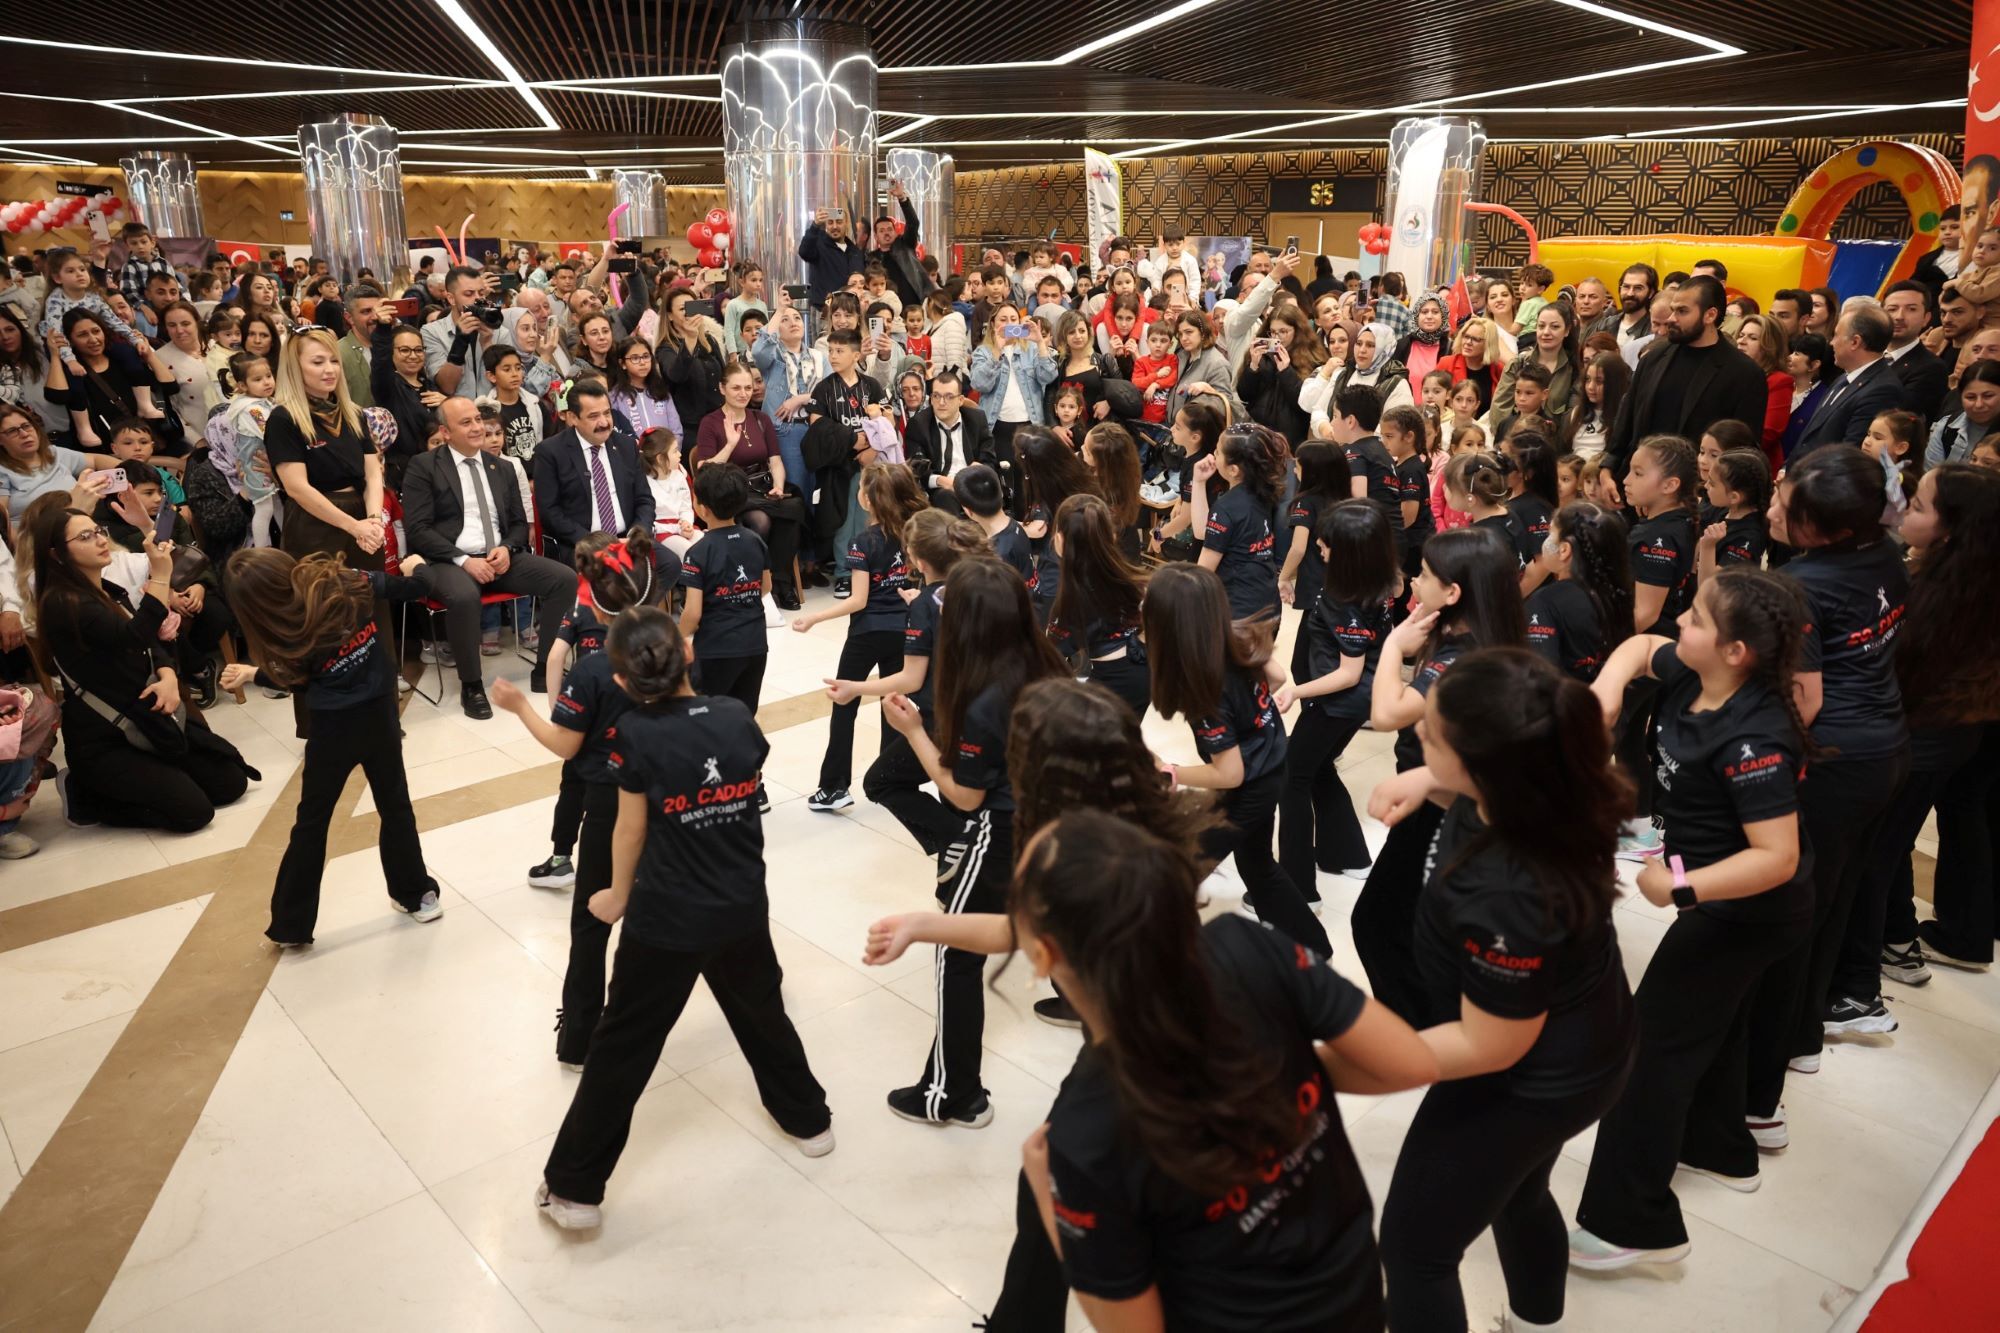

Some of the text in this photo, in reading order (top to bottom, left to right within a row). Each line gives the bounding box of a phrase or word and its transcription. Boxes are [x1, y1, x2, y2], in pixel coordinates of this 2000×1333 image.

[1740, 752, 1784, 774] CADDE
[663, 794, 692, 814] 20.
[1484, 950, 1543, 970] CADDE
